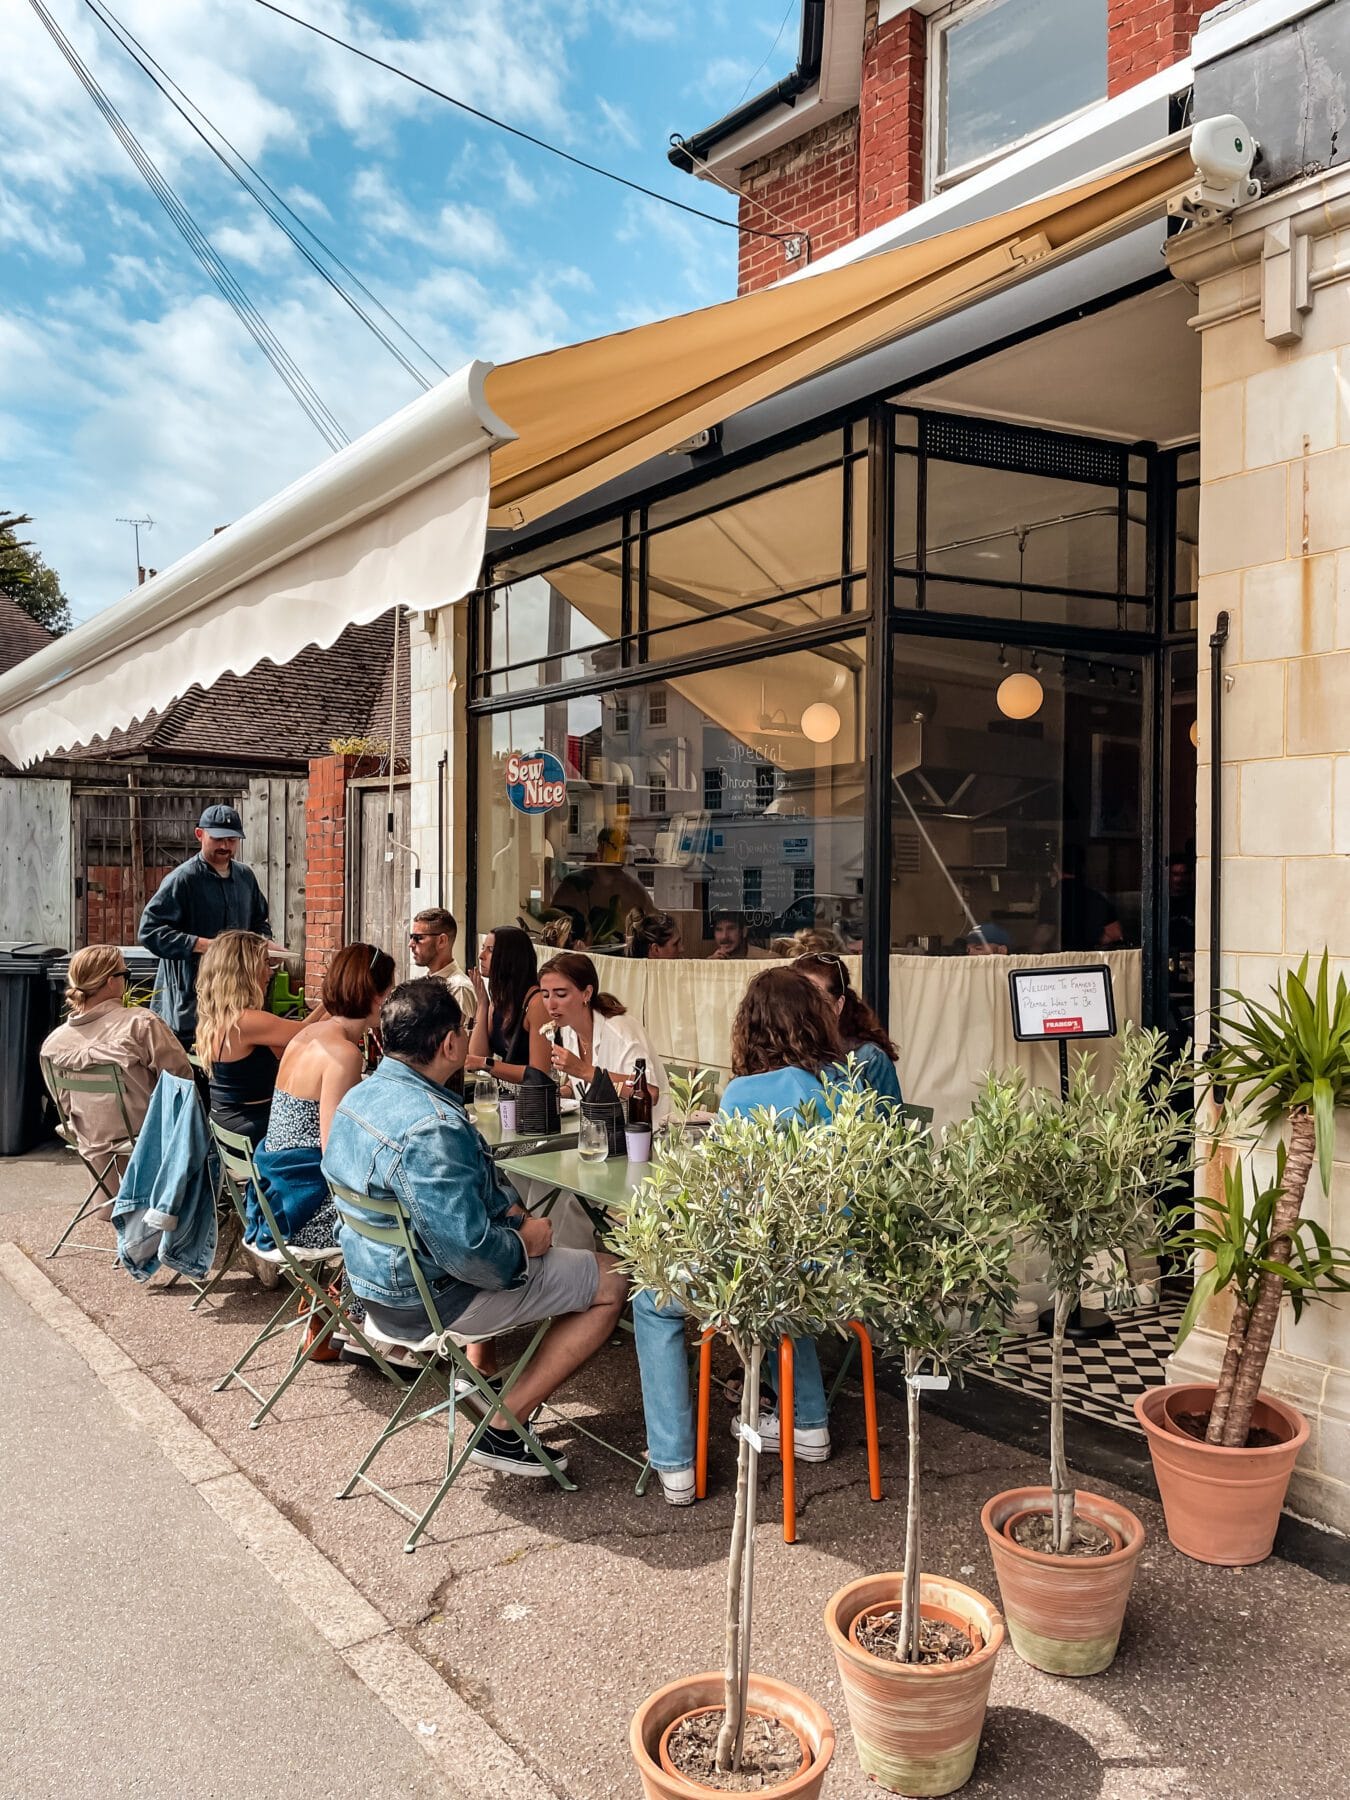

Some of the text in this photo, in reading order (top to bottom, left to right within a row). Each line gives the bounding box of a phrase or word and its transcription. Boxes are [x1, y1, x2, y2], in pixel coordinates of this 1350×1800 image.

[727, 743, 786, 765] Special
[508, 758, 543, 782] Sew
[524, 779, 563, 804] Nice
[1046, 1020, 1078, 1028] FRANCO'S
